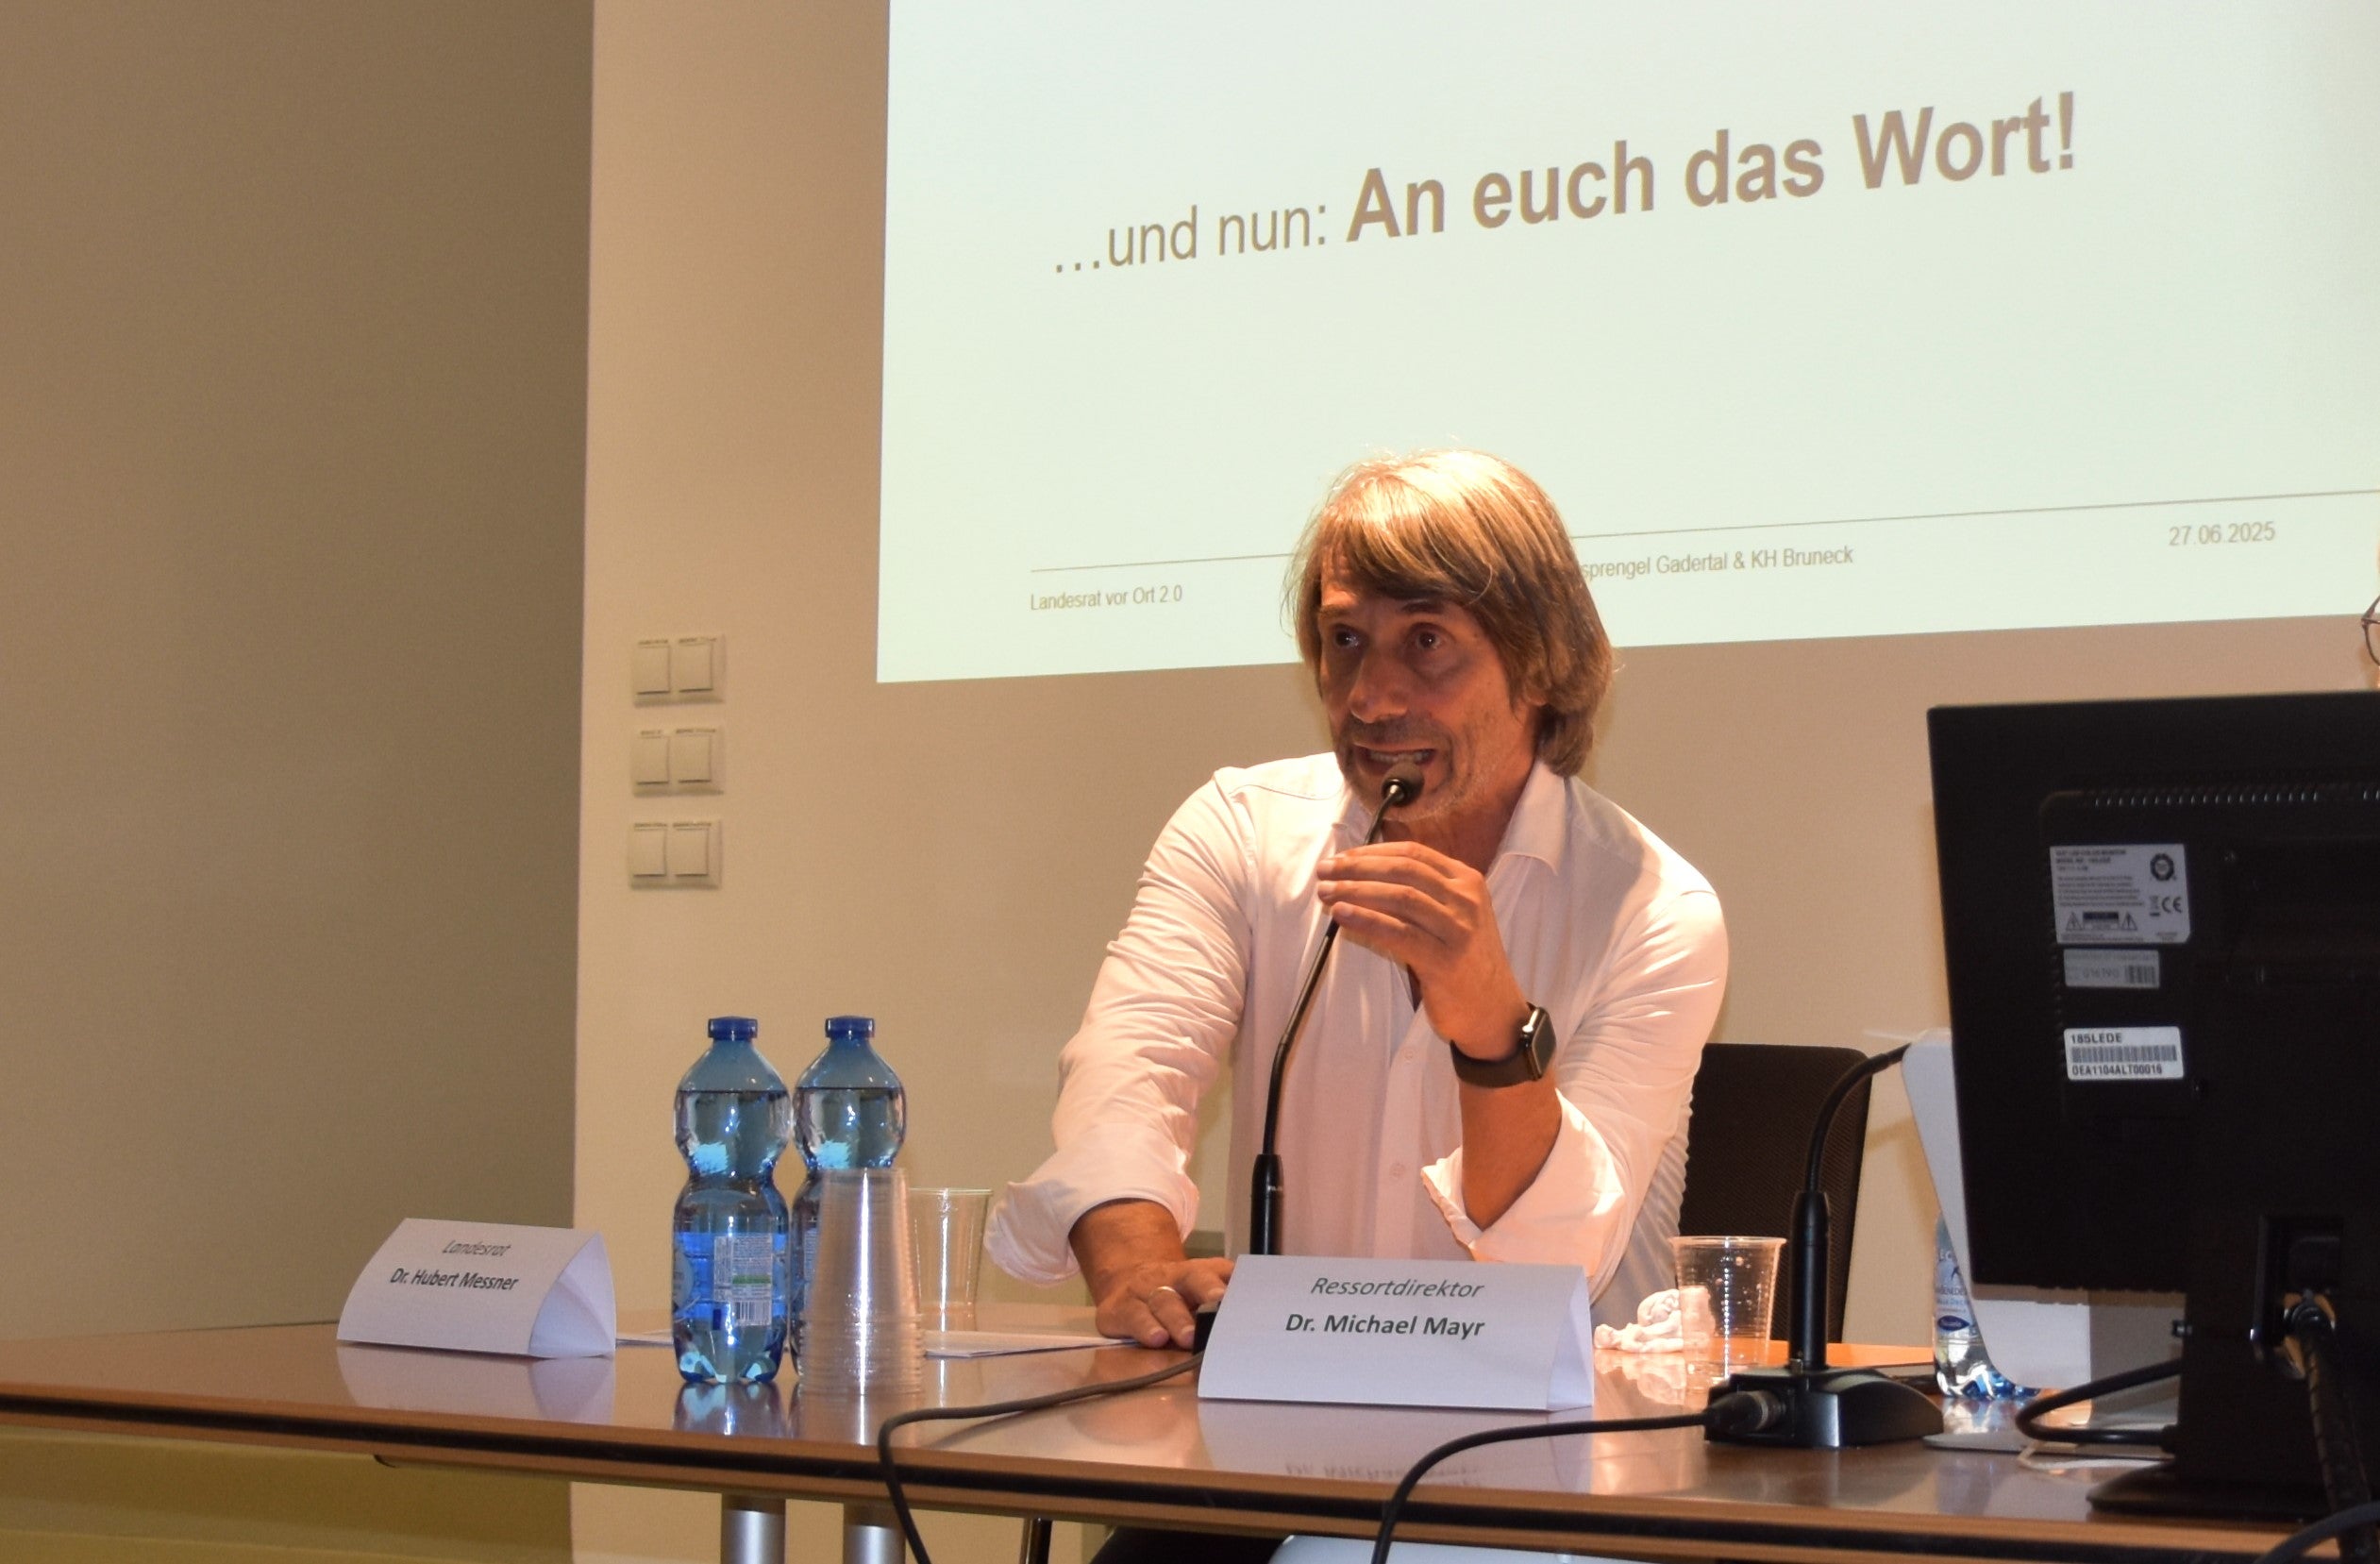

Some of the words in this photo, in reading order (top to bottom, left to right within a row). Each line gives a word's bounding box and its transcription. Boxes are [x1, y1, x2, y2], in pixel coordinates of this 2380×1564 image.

[1217, 201, 1328, 257] nun:
[1346, 166, 1445, 244] An
[1472, 138, 1655, 228] euch
[1683, 128, 1824, 210] das
[1852, 91, 2078, 191] Wort!
[1582, 558, 1651, 580] sprengel
[1656, 551, 1728, 574] Gadertal
[1734, 550, 1745, 569] &
[1751, 549, 1777, 568] KH
[1783, 546, 1853, 568] Bruneck
[1031, 591, 1101, 610] Landesrat
[1106, 591, 1129, 606] vor
[1132, 586, 1155, 604] Ort
[2070, 1033, 2122, 1044] 185LEDE
[442, 1239, 511, 1257] Landesrat
[390, 1268, 409, 1285] Dr.
[412, 1269, 459, 1287] Hubert
[460, 1271, 519, 1291] Messner
[1310, 1277, 1485, 1299] Ressortdirektor
[1285, 1314, 1316, 1333] Dr.
[1323, 1315, 1417, 1335] Michael
[1422, 1318, 1485, 1339] Mayr
